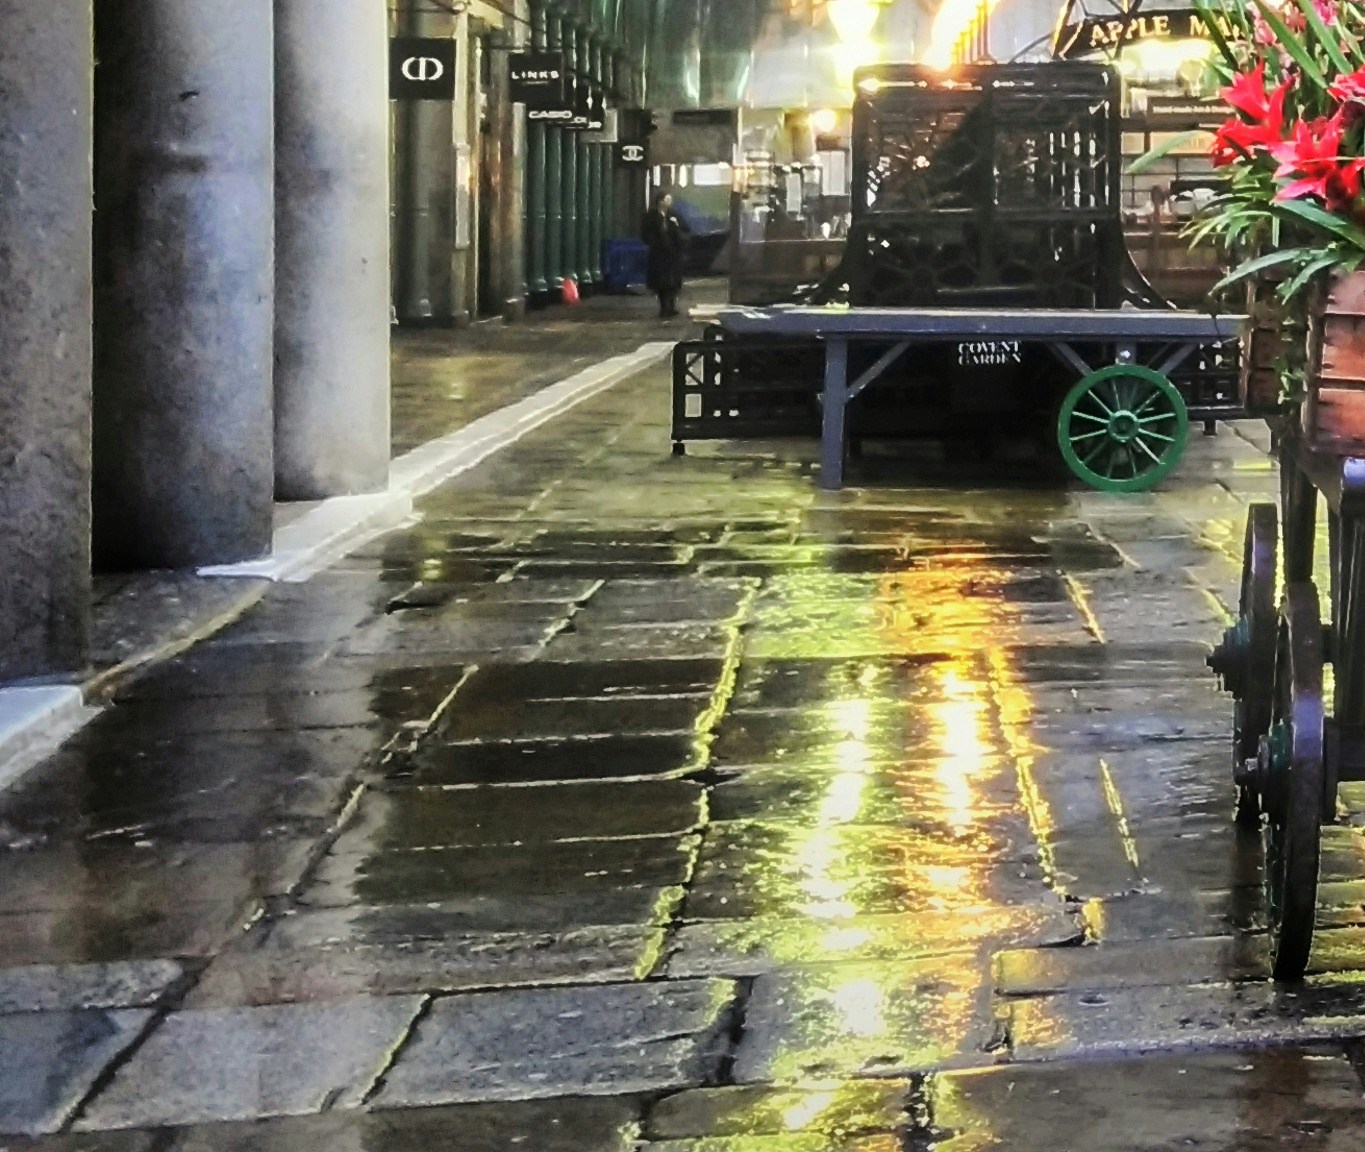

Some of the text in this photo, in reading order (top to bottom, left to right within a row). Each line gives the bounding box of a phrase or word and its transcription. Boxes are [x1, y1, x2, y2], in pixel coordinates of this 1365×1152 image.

[1090, 15, 1171, 48] APPLE
[511, 70, 560, 80] LINKS
[959, 341, 1021, 353] COVENT
[959, 353, 1021, 365] GARDEN
